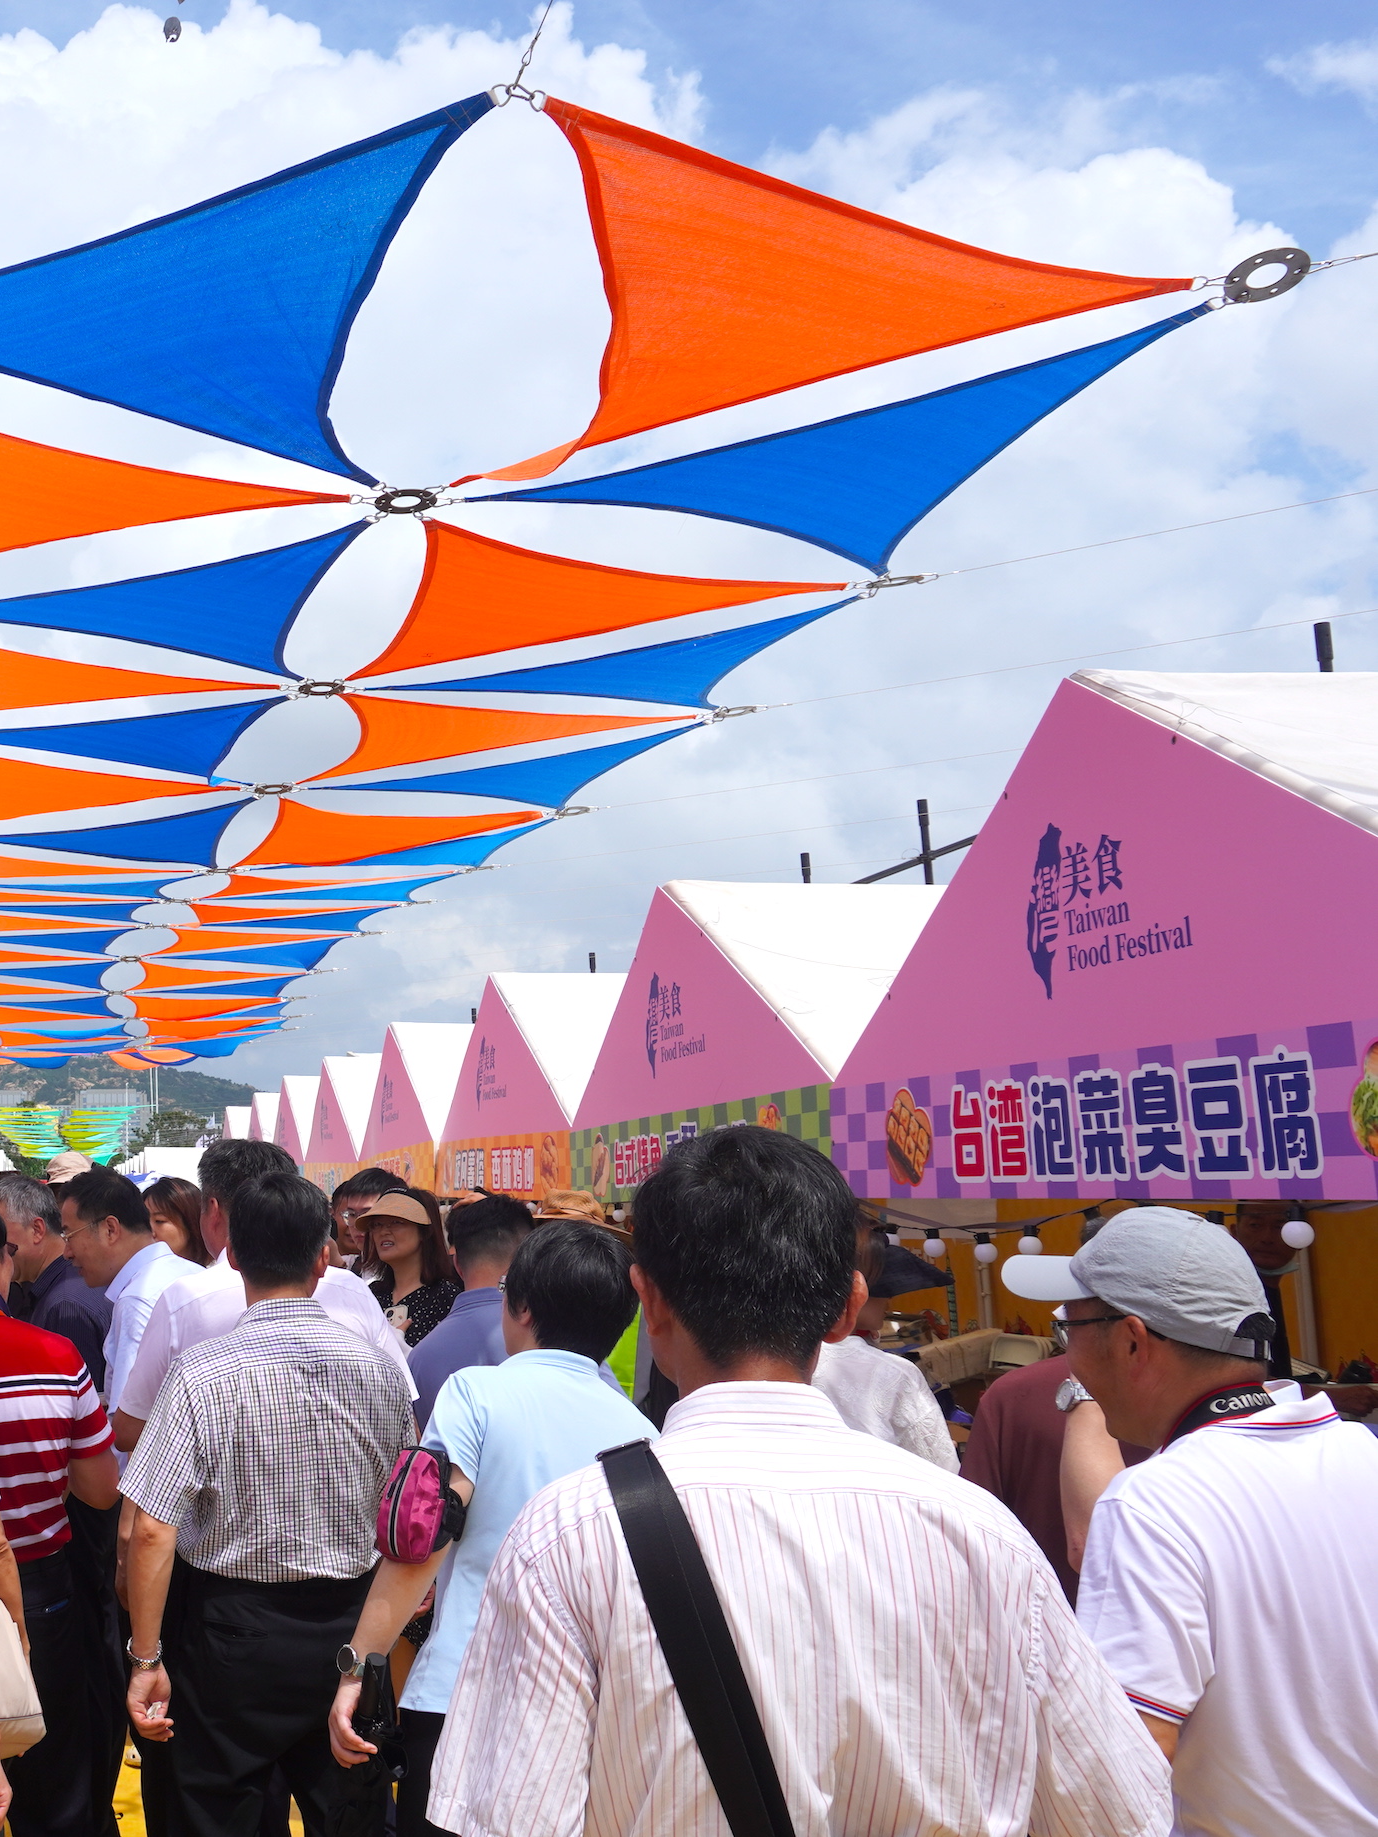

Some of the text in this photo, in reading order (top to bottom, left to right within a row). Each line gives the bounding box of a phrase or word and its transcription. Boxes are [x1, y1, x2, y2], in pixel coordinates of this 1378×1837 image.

[1062, 834, 1123, 907] 美食
[1064, 901, 1131, 936] Taiwan
[1067, 915, 1193, 972] Food Festival
[659, 982, 682, 1022] 美食
[660, 1022, 684, 1041] Taiwan
[661, 1033, 706, 1062] Food Festival
[952, 1052, 1320, 1180] 台湾泡菜臭豆腐
[1209, 1392, 1273, 1414] Canon
